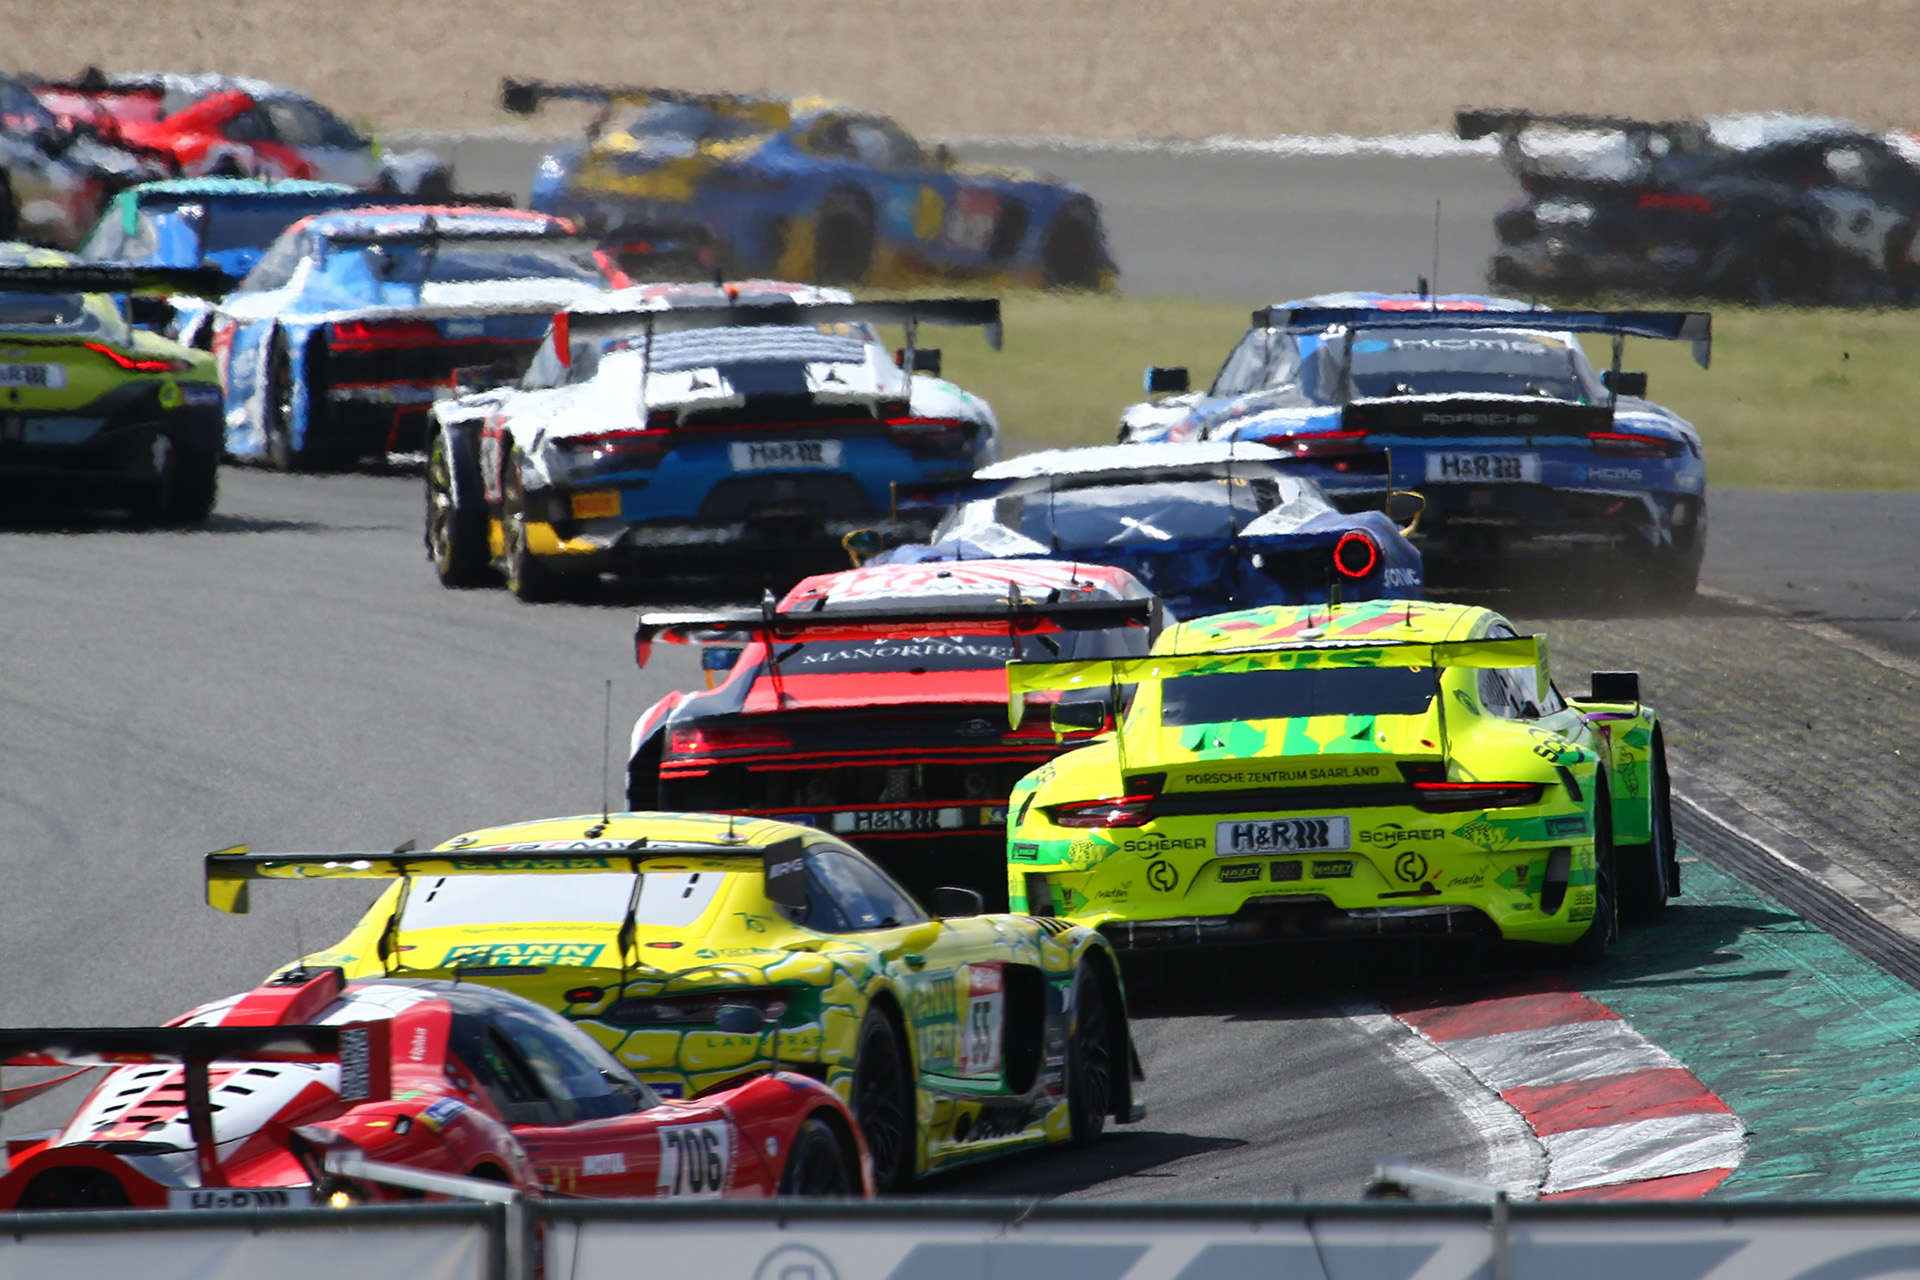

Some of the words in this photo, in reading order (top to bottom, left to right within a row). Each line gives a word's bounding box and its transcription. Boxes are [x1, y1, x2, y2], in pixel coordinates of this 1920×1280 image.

[1441, 455, 1490, 476] H&R
[1186, 772, 1245, 784] PORSCHE
[1248, 770, 1307, 783] ZENTRUM
[1309, 766, 1379, 779] SAARLAND
[856, 808, 908, 829] H&R
[1231, 822, 1291, 849] H&R
[1360, 828, 1446, 842] SCHERER
[1124, 838, 1207, 852] SCHERER
[1221, 867, 1259, 879] HAZET
[451, 945, 596, 958] MANN
[443, 956, 586, 968] FLTER
[666, 1128, 723, 1196] 706
